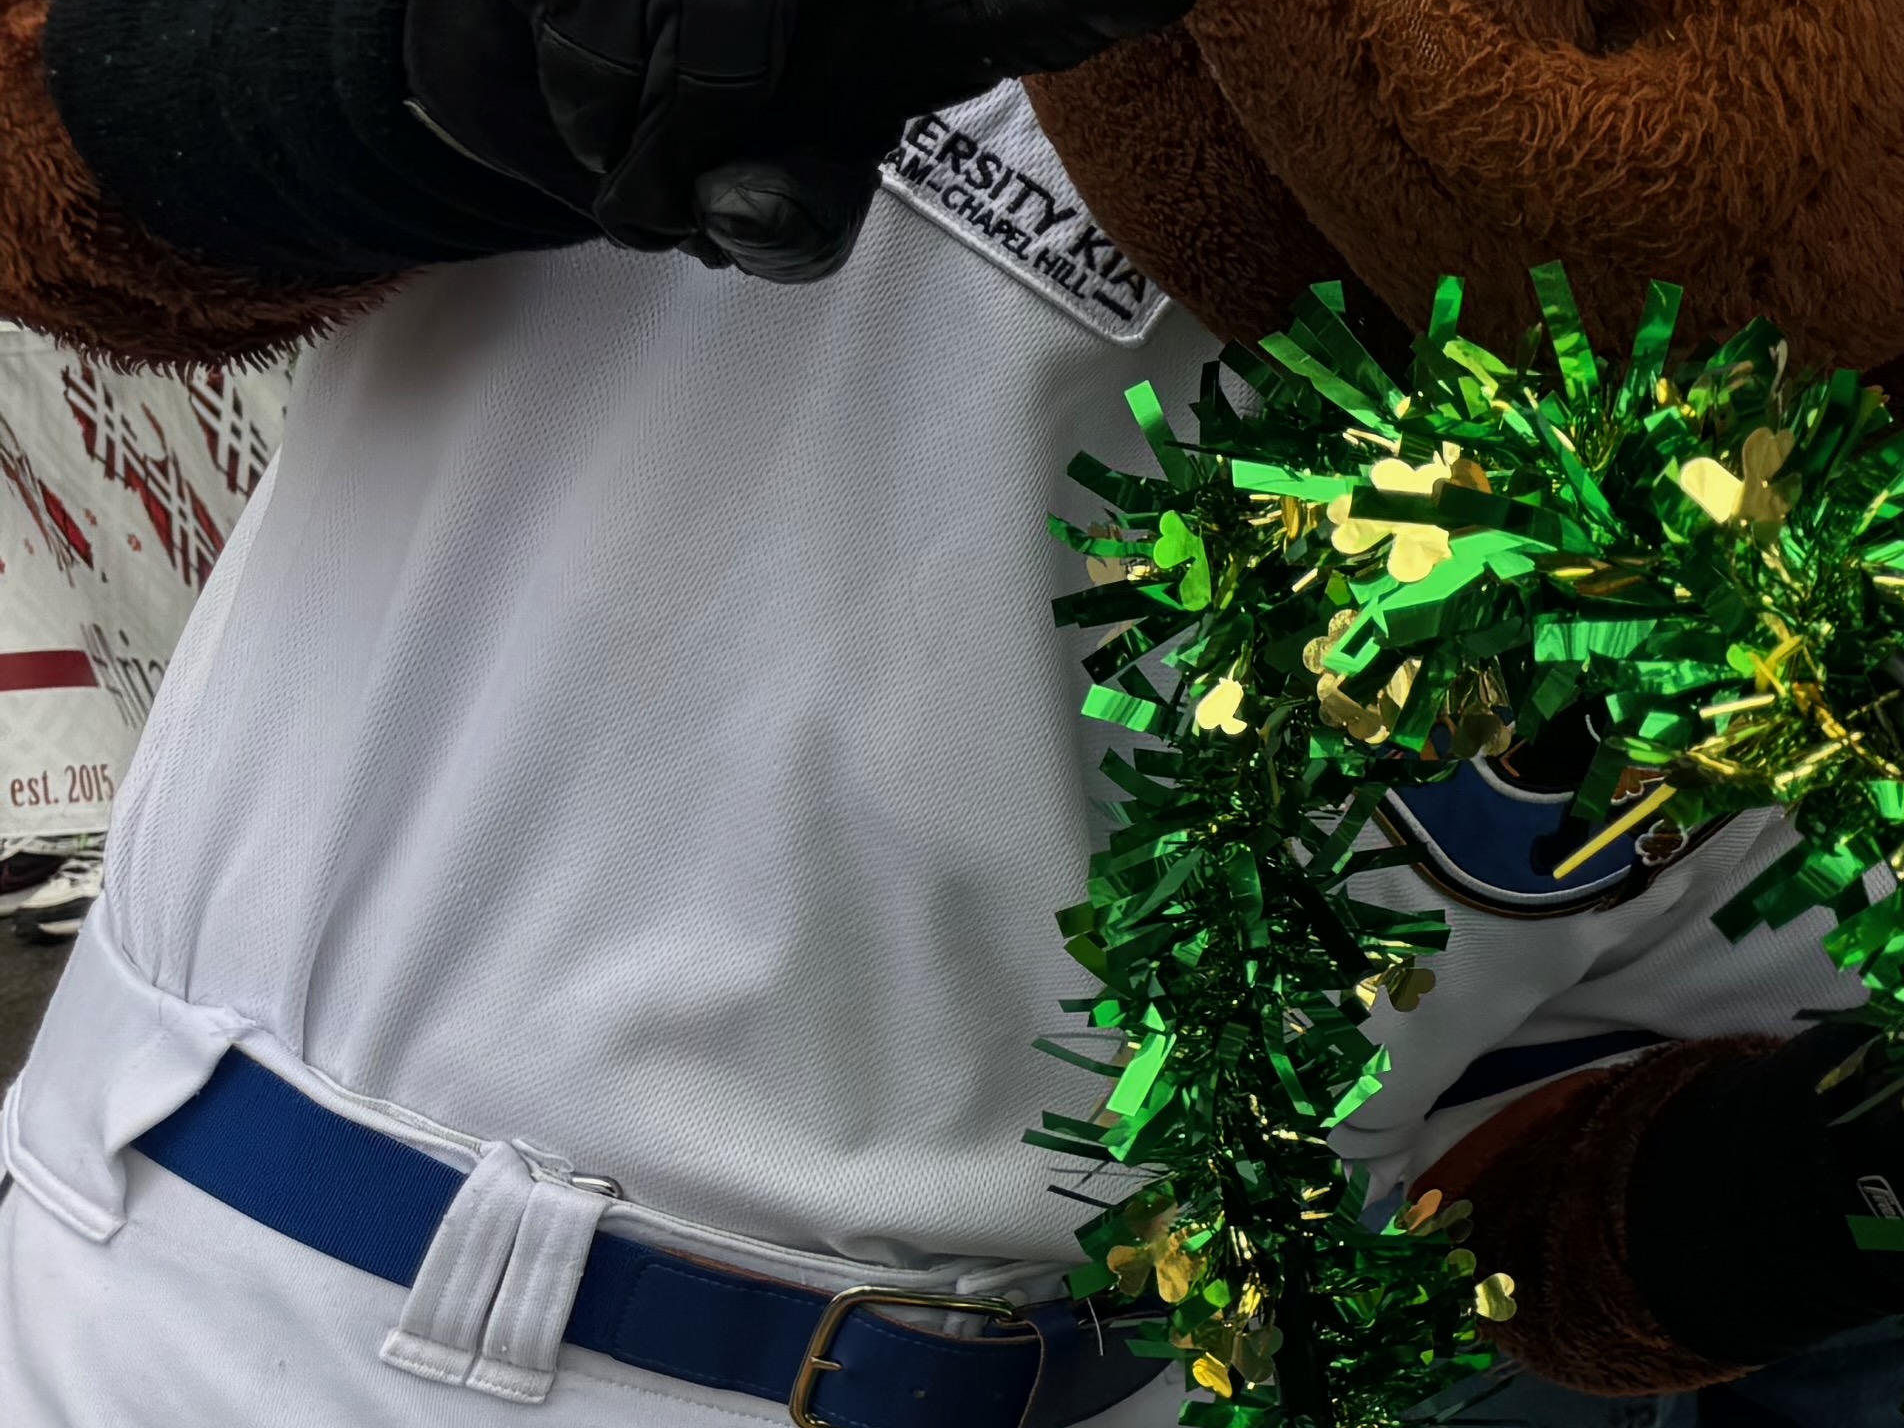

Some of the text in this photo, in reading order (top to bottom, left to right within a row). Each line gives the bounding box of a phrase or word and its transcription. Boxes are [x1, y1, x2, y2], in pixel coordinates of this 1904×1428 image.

[883, 147, 1092, 300] AM-CHAPEL HILL
[905, 113, 1149, 304] ERSITY KIA
[9, 763, 115, 808] est. 2015
